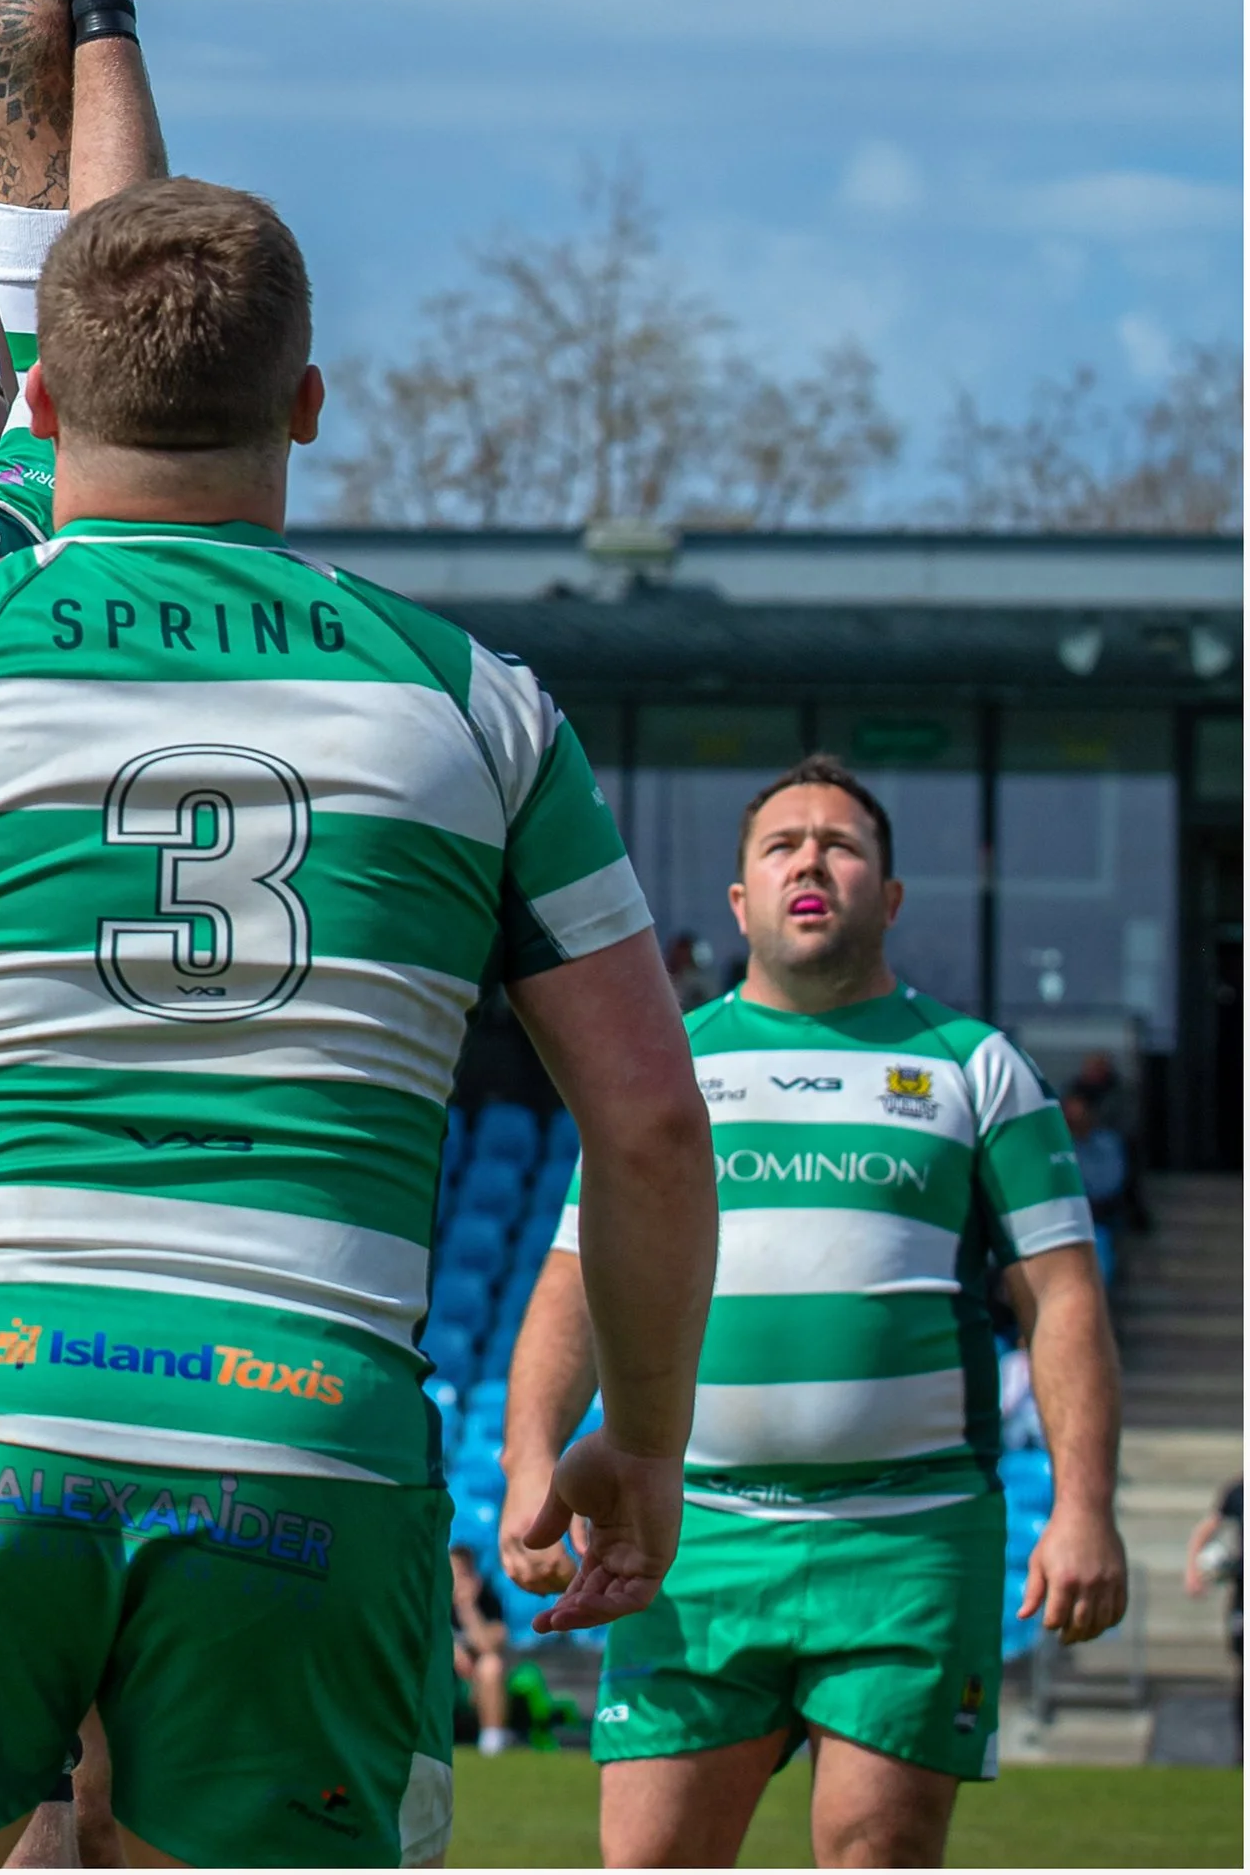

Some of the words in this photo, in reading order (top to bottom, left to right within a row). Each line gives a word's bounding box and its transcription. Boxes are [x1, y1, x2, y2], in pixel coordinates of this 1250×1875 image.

[51, 598, 346, 654] SPRING
[96, 743, 313, 1024] 3
[175, 984, 227, 997] VX3
[769, 1076, 843, 1093] VX3
[121, 1125, 254, 1152] VX3
[49, 1329, 345, 1406] IslandTaxis
